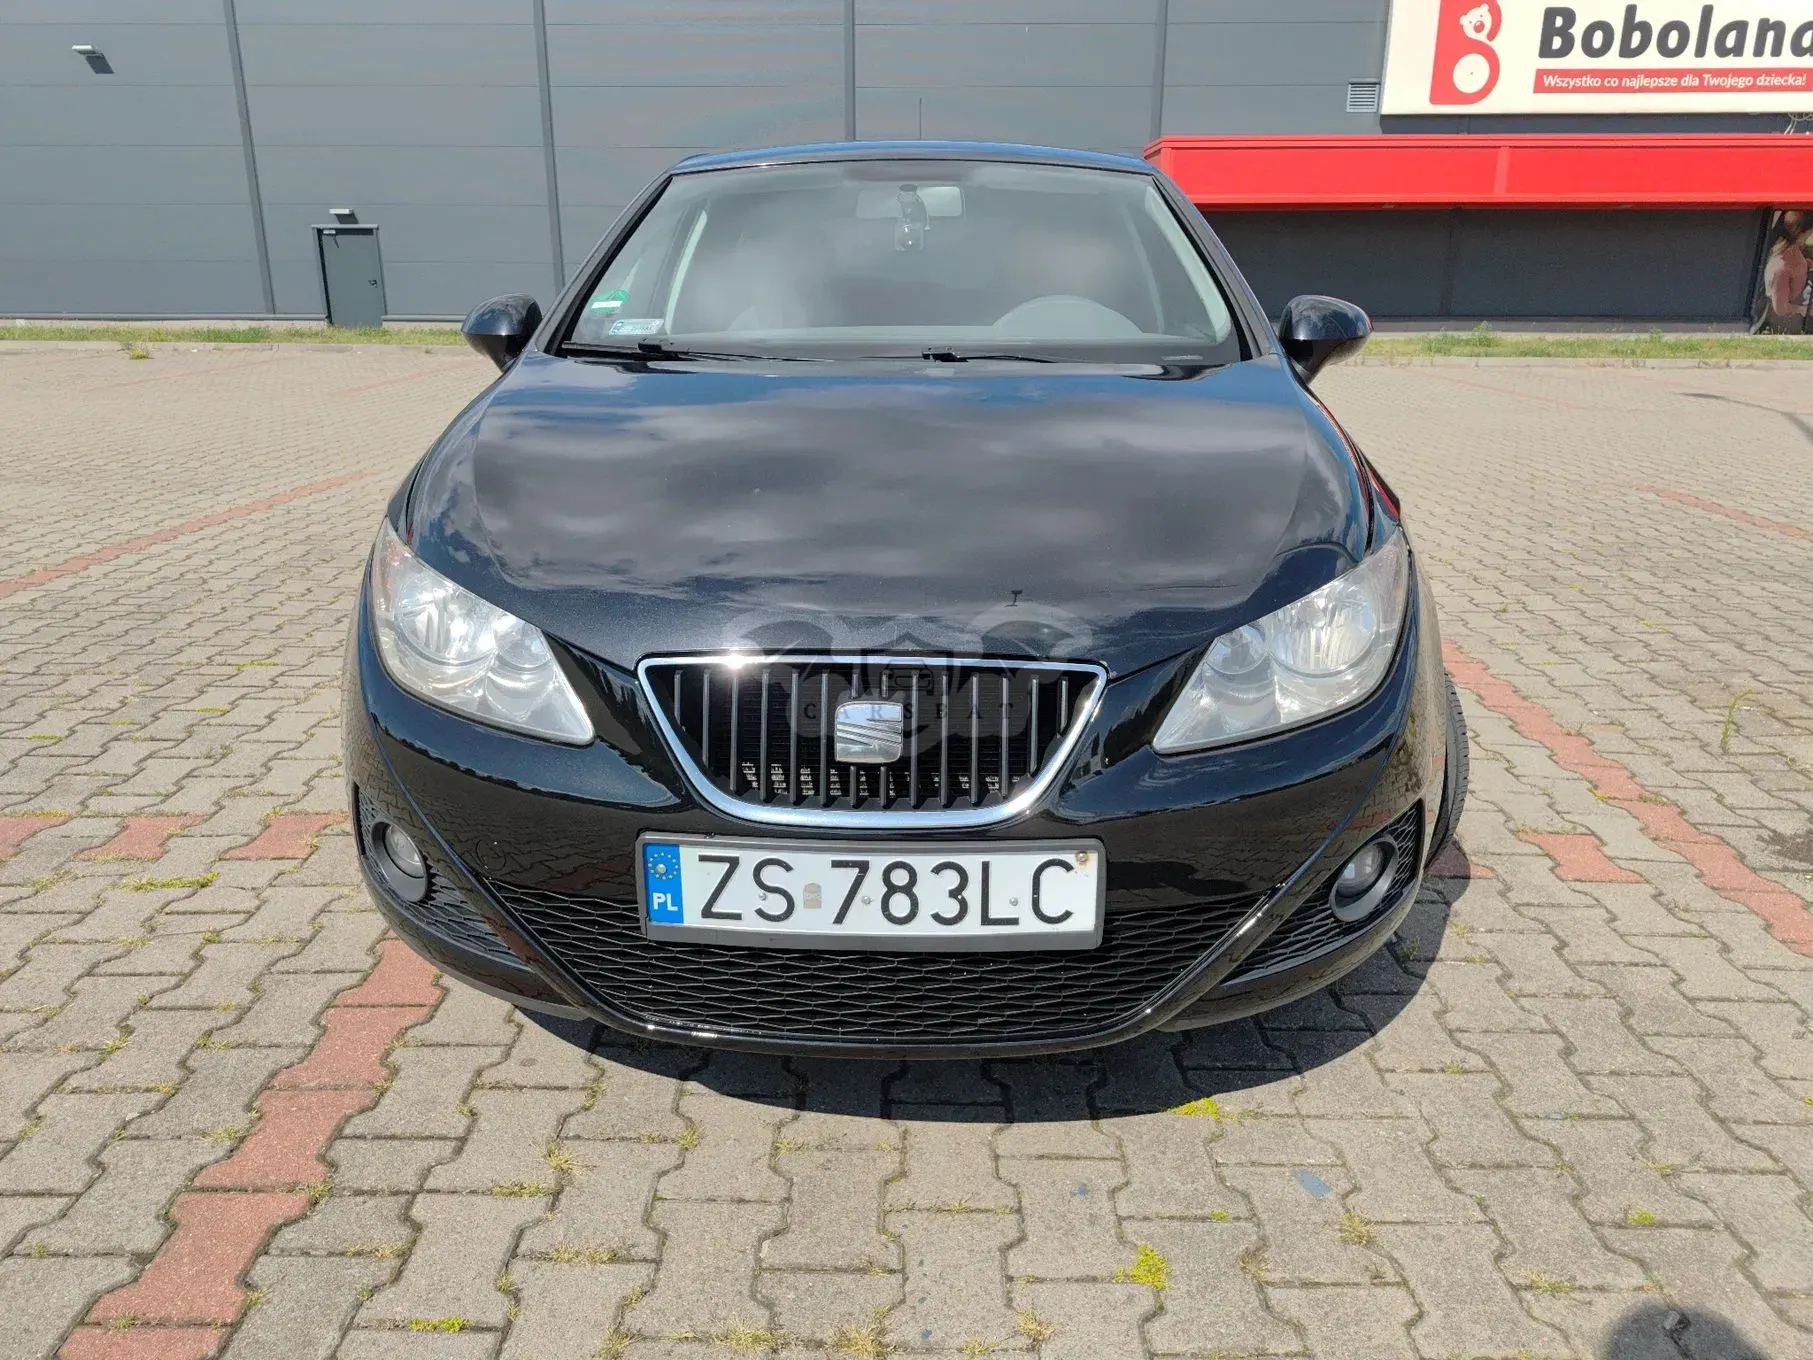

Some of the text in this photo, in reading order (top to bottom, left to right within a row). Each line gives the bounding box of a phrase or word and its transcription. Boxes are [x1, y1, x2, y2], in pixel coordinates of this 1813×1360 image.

[1542, 73, 1807, 89] Wszystko co najlepsze dla Twojego dziecka!
[698, 854, 1075, 926] ZS 783LC
[652, 892, 679, 912] PL
